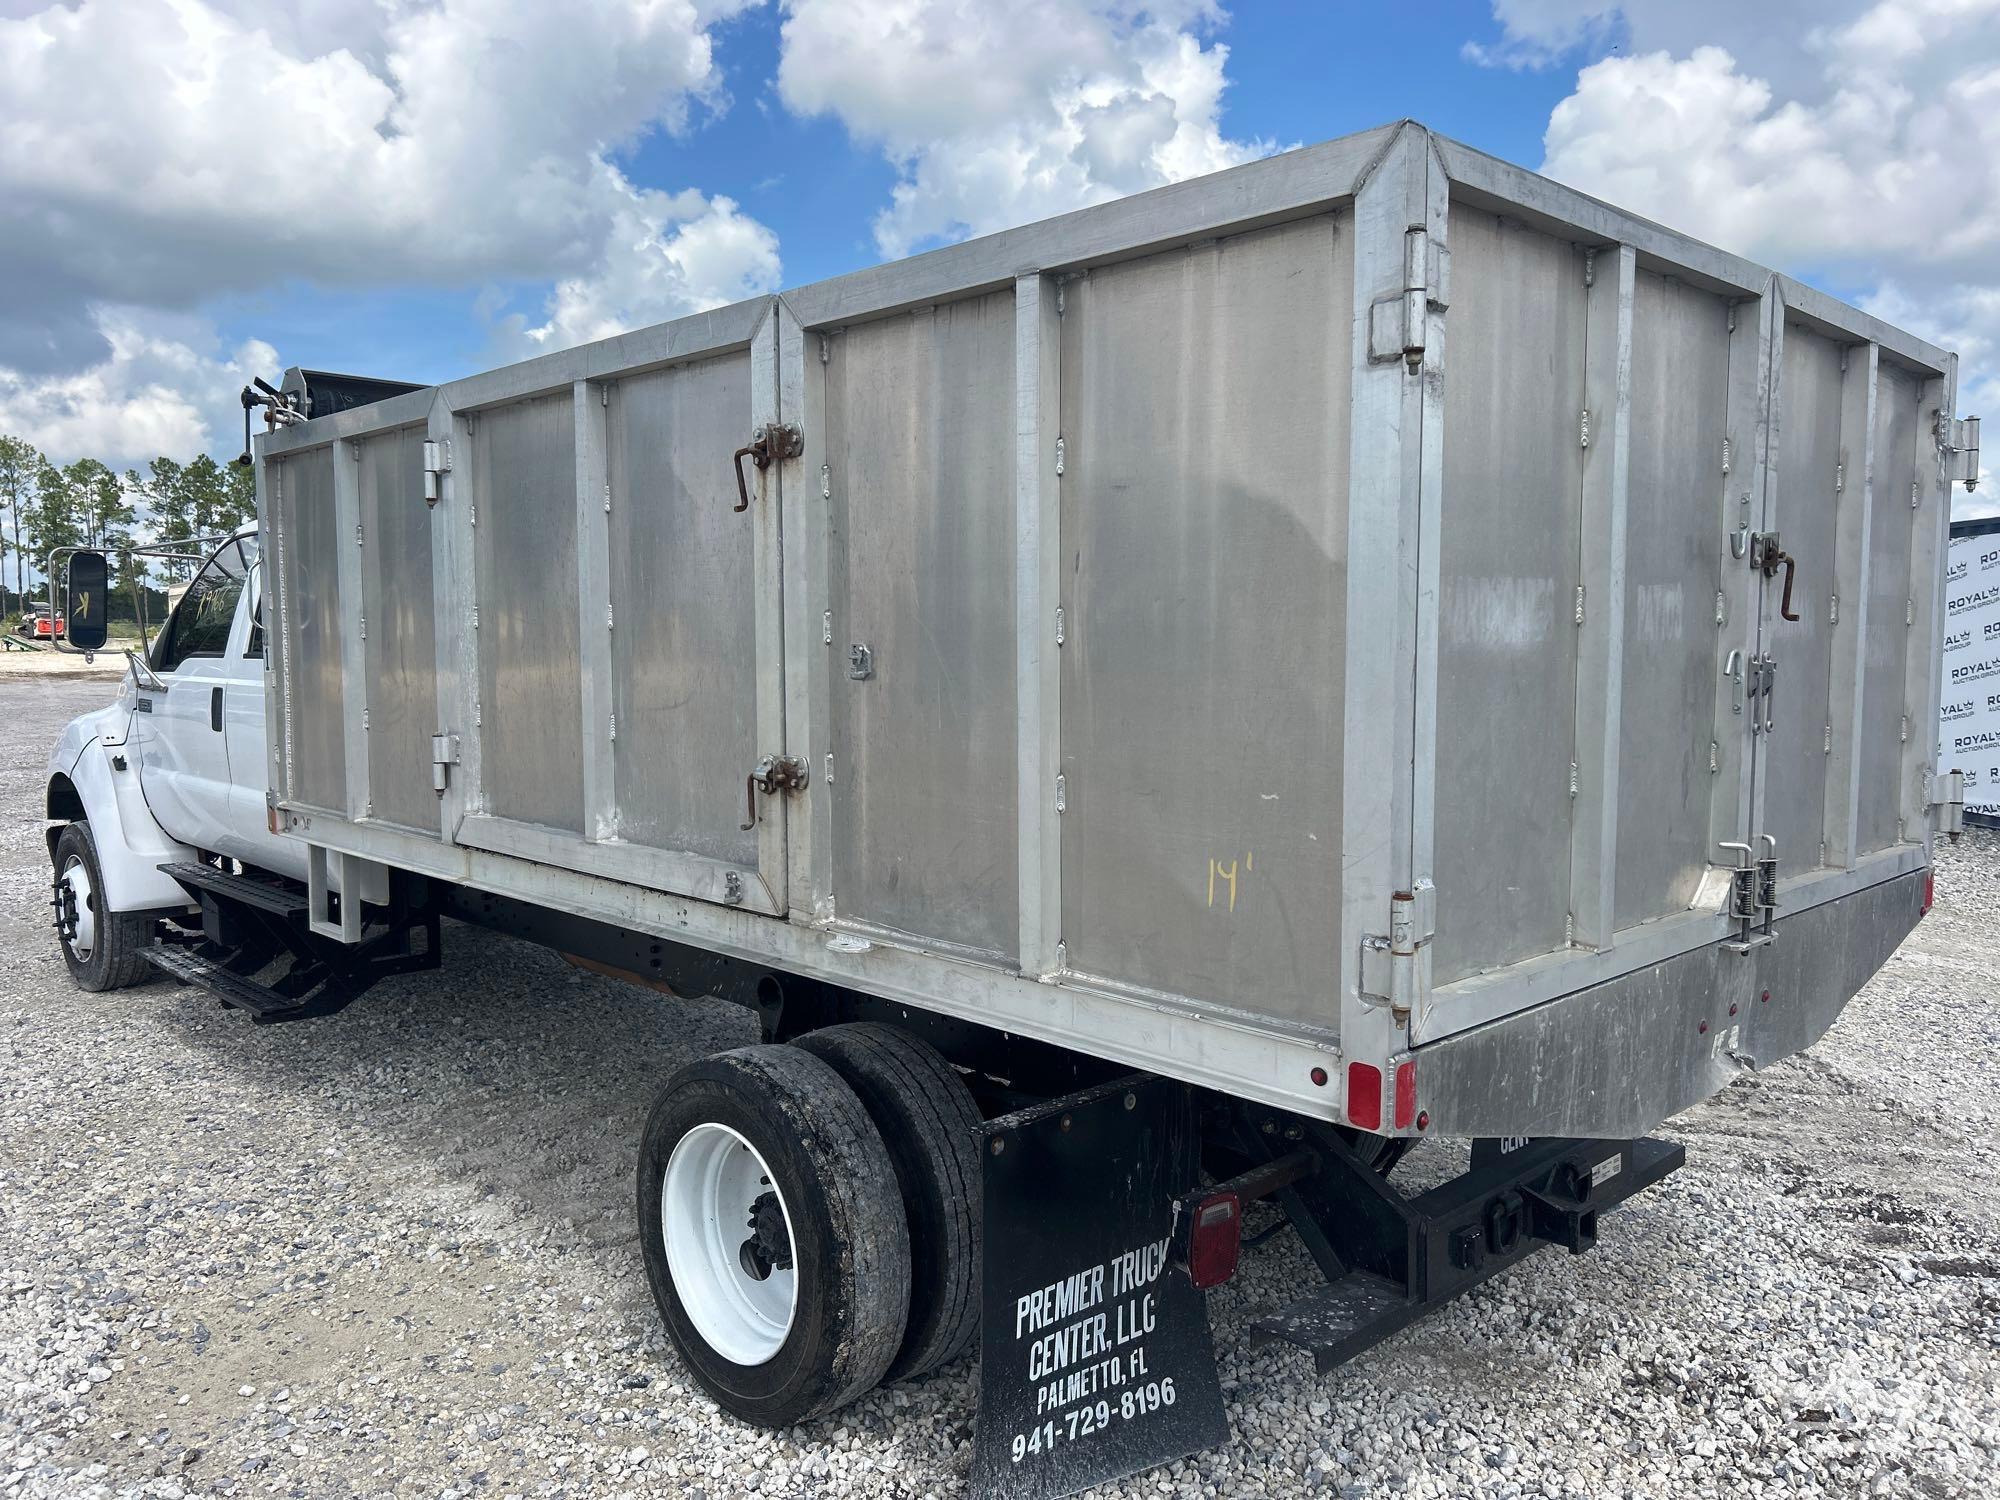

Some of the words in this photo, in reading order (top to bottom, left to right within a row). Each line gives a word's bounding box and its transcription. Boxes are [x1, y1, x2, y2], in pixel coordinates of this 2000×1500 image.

[1948, 591, 1988, 610] ROYAL
[1949, 605, 1977, 616] AUCTION
[1977, 597, 2000, 608] GROUP
[1949, 641, 1971, 652] GROUP
[1952, 661, 1992, 678] ROYAL
[1952, 674, 1980, 685] AUCTION
[1952, 711, 1975, 720] GROUP
[1954, 732, 1996, 748] ROYAL
[1955, 745, 1983, 754] AUCTION
[1015, 1264, 1105, 1340] PREMIER
[1111, 1235, 1171, 1298] TRUCK
[1028, 1312, 1112, 1382] CENTER,
[1116, 1293, 1156, 1346] LLC
[1036, 1356, 1126, 1416] PALMETTO,
[1130, 1347, 1149, 1379] FL
[1011, 1377, 1176, 1463] 941-729-8196
